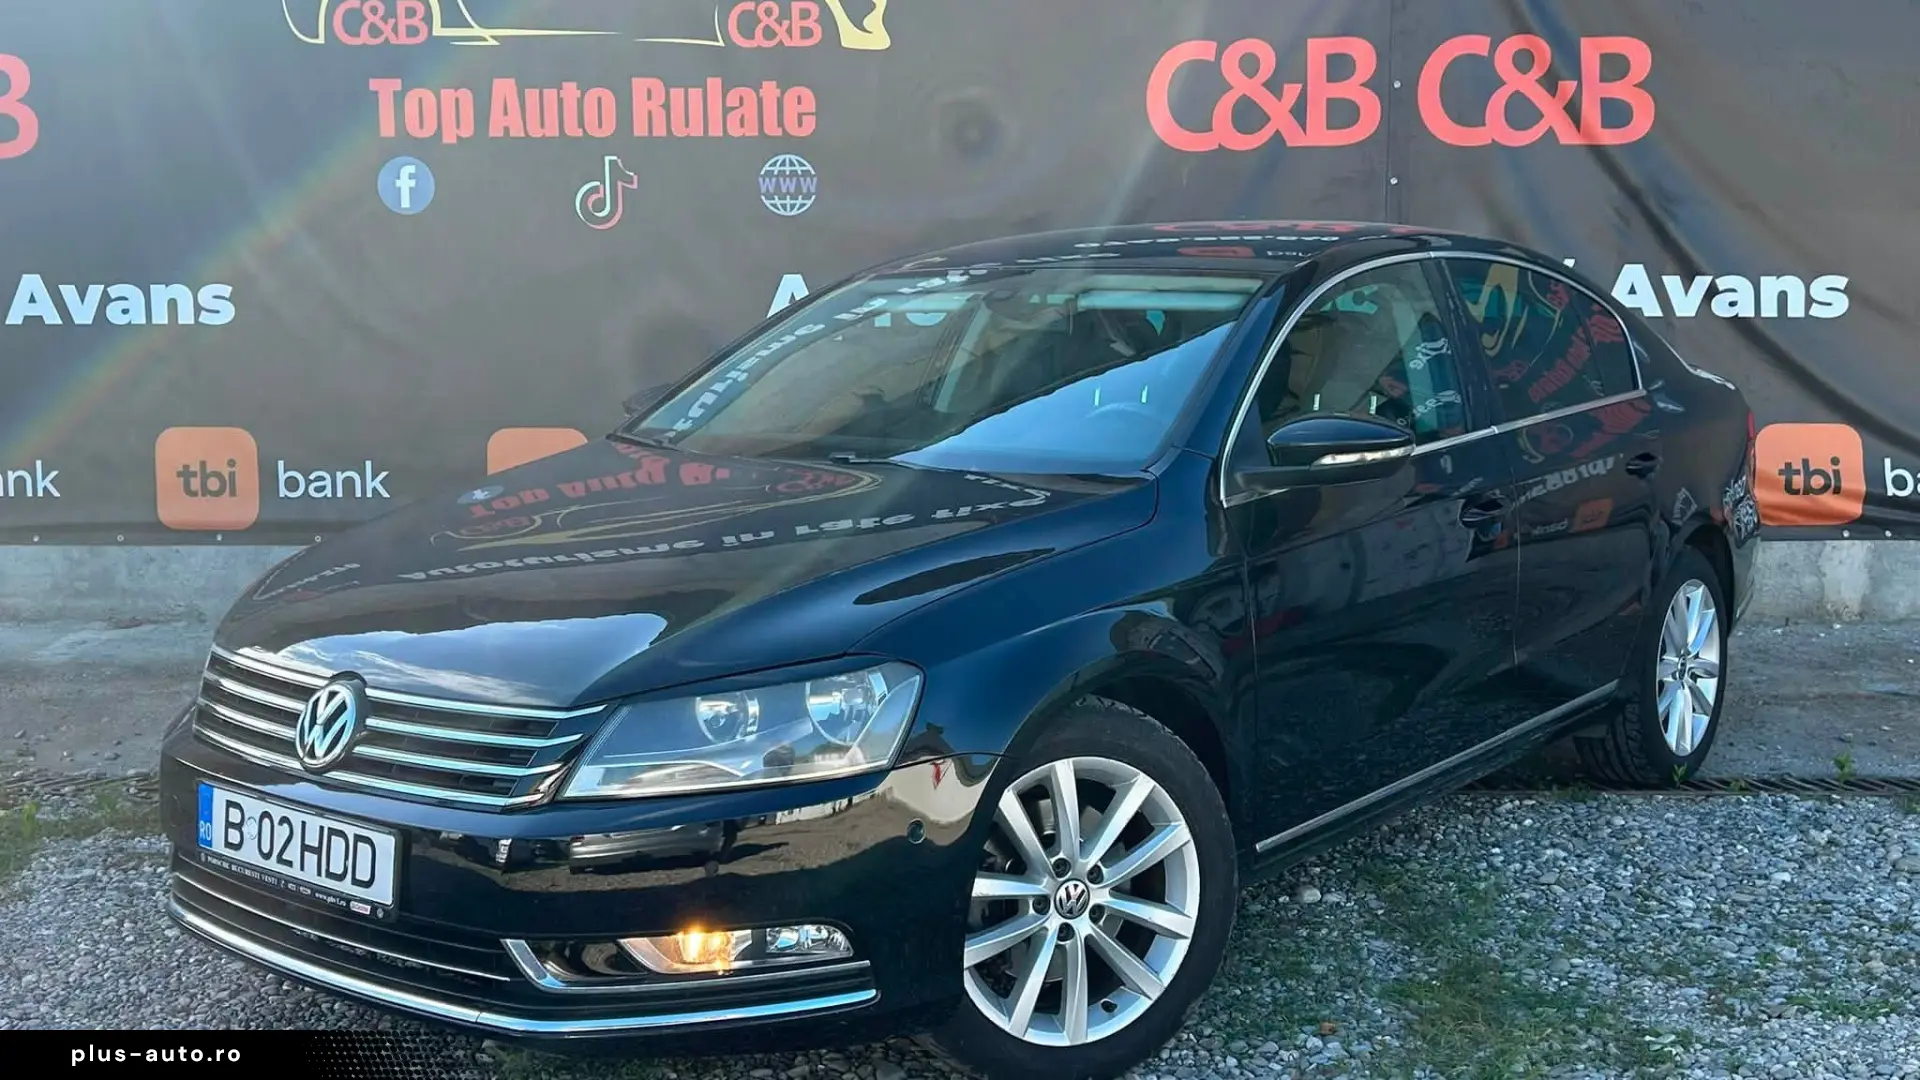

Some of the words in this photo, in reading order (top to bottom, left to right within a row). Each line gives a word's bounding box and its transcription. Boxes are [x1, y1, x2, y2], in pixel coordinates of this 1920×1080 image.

[333, 0, 429, 46] C&B
[728, 0, 823, 48] C&B
[369, 78, 474, 144] Top
[488, 78, 617, 138] Auto
[632, 77, 816, 138] Rulate
[1146, 35, 1382, 152] C&B
[1416, 34, 1655, 147] C&B
[5, 274, 236, 325] Avans
[1611, 263, 1849, 319] Avans
[0, 459, 61, 498] nk
[176, 458, 239, 499] tbi
[277, 460, 390, 499] bank
[1777, 456, 1842, 496] tbi
[1884, 457, 1920, 497] b
[199, 819, 213, 841] RO
[223, 798, 246, 851] B
